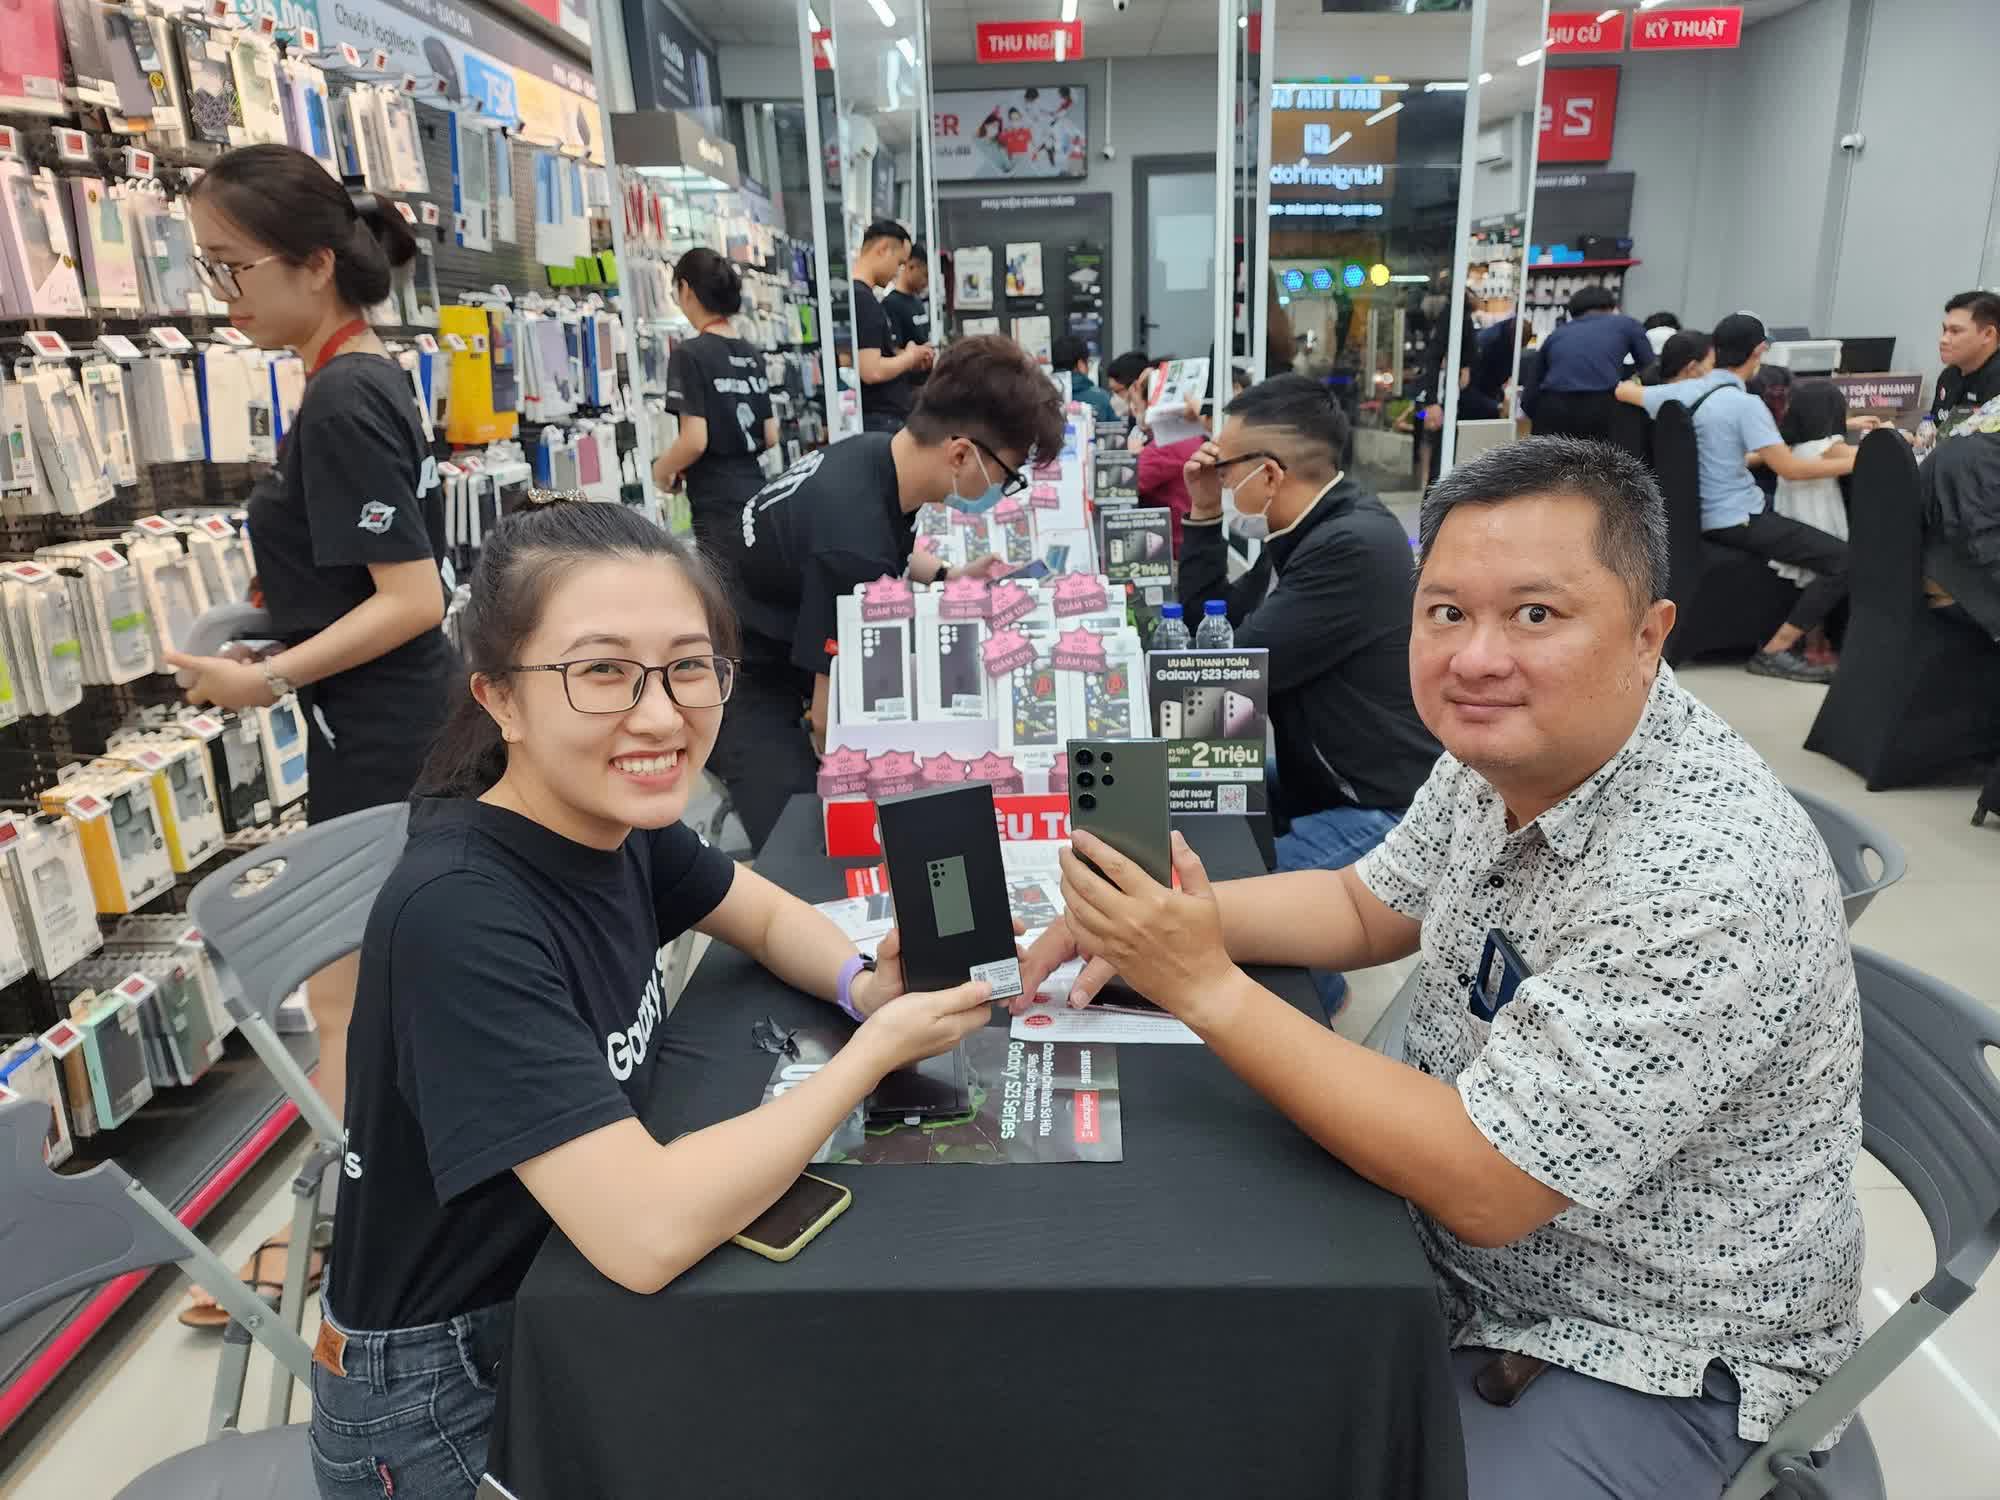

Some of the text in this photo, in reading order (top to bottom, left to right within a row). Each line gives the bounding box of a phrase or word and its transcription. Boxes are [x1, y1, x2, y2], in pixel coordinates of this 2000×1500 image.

[1548, 26, 1575, 44] HU
[1645, 16, 1728, 40] KỸ THUẬT
[988, 33, 1023, 53] THU
[1879, 383, 1915, 395] NHANH
[1195, 657, 1224, 667] THANH
[1226, 656, 1249, 667] TOÁN
[1156, 667, 1261, 682] Galaxy S23 Series
[1192, 741, 1209, 767] 2
[1211, 745, 1259, 767] Triệu
[1191, 789, 1212, 798] NGAY
[1080, 1049, 1092, 1084] SAMSUNG
[1000, 1041, 1024, 1139] Galaxy S23 Series
